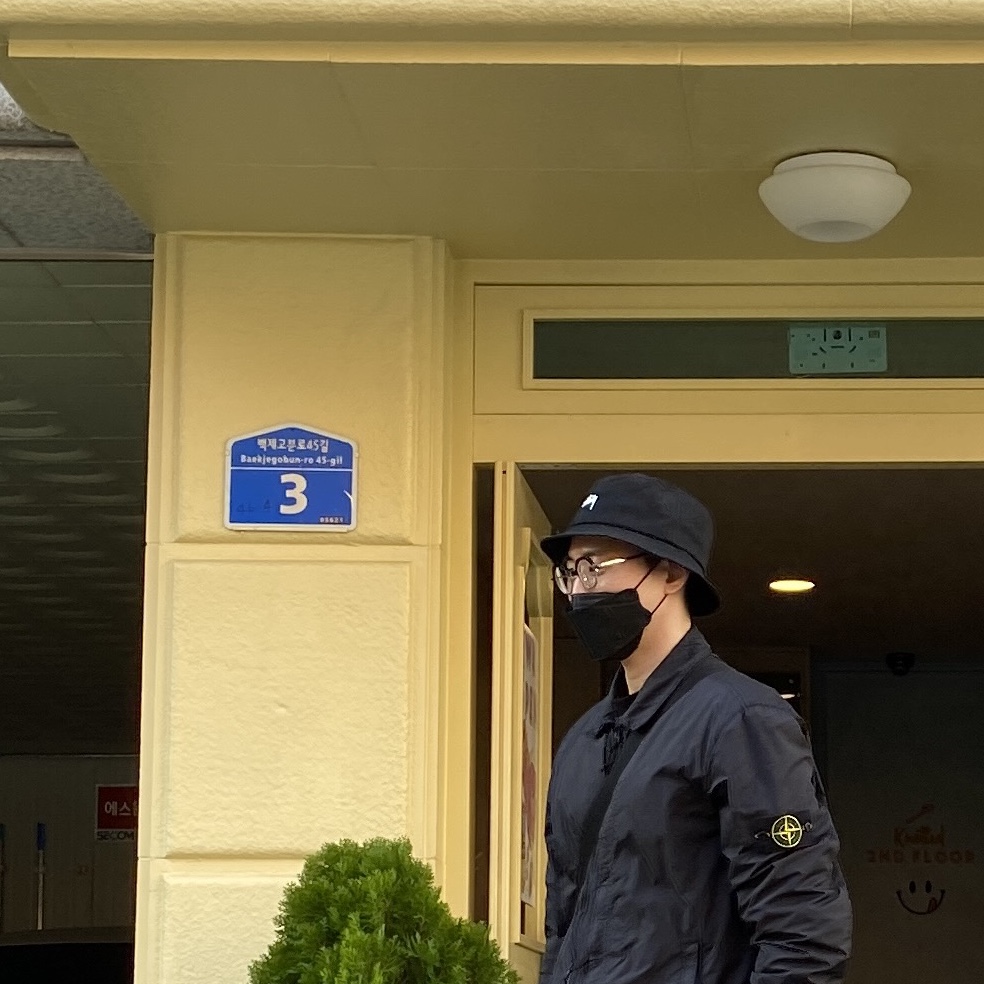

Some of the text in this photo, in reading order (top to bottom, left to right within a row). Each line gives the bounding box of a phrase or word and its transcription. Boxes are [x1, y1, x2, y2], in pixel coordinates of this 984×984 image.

[240, 454, 343, 466] Baekjegobun-ro 45-gil
[279, 473, 308, 515] 3
